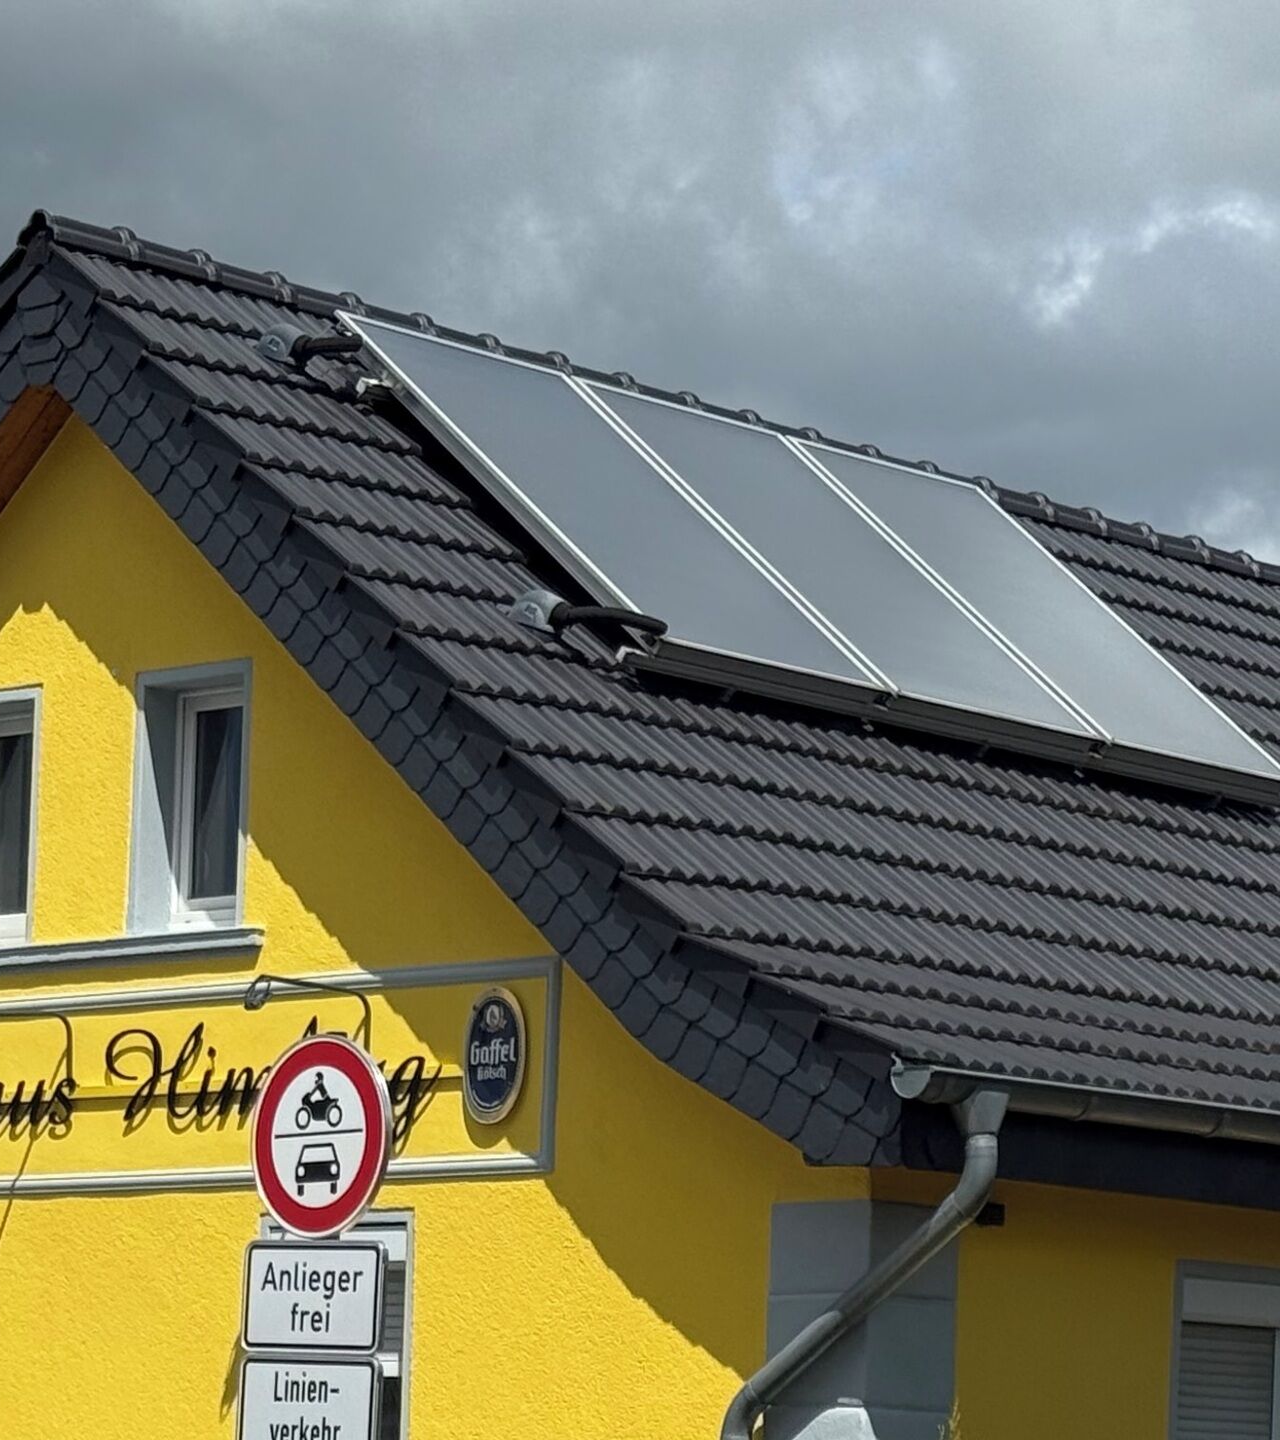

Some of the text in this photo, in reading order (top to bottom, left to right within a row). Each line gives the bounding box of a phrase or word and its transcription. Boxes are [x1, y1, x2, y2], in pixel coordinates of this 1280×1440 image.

[471, 1037, 516, 1065] Gaffel
[106, 1015, 442, 1146] Himg
[261, 1261, 363, 1300] Anlieger
[291, 1303, 331, 1333] frei
[273, 1371, 340, 1403] Linien-
